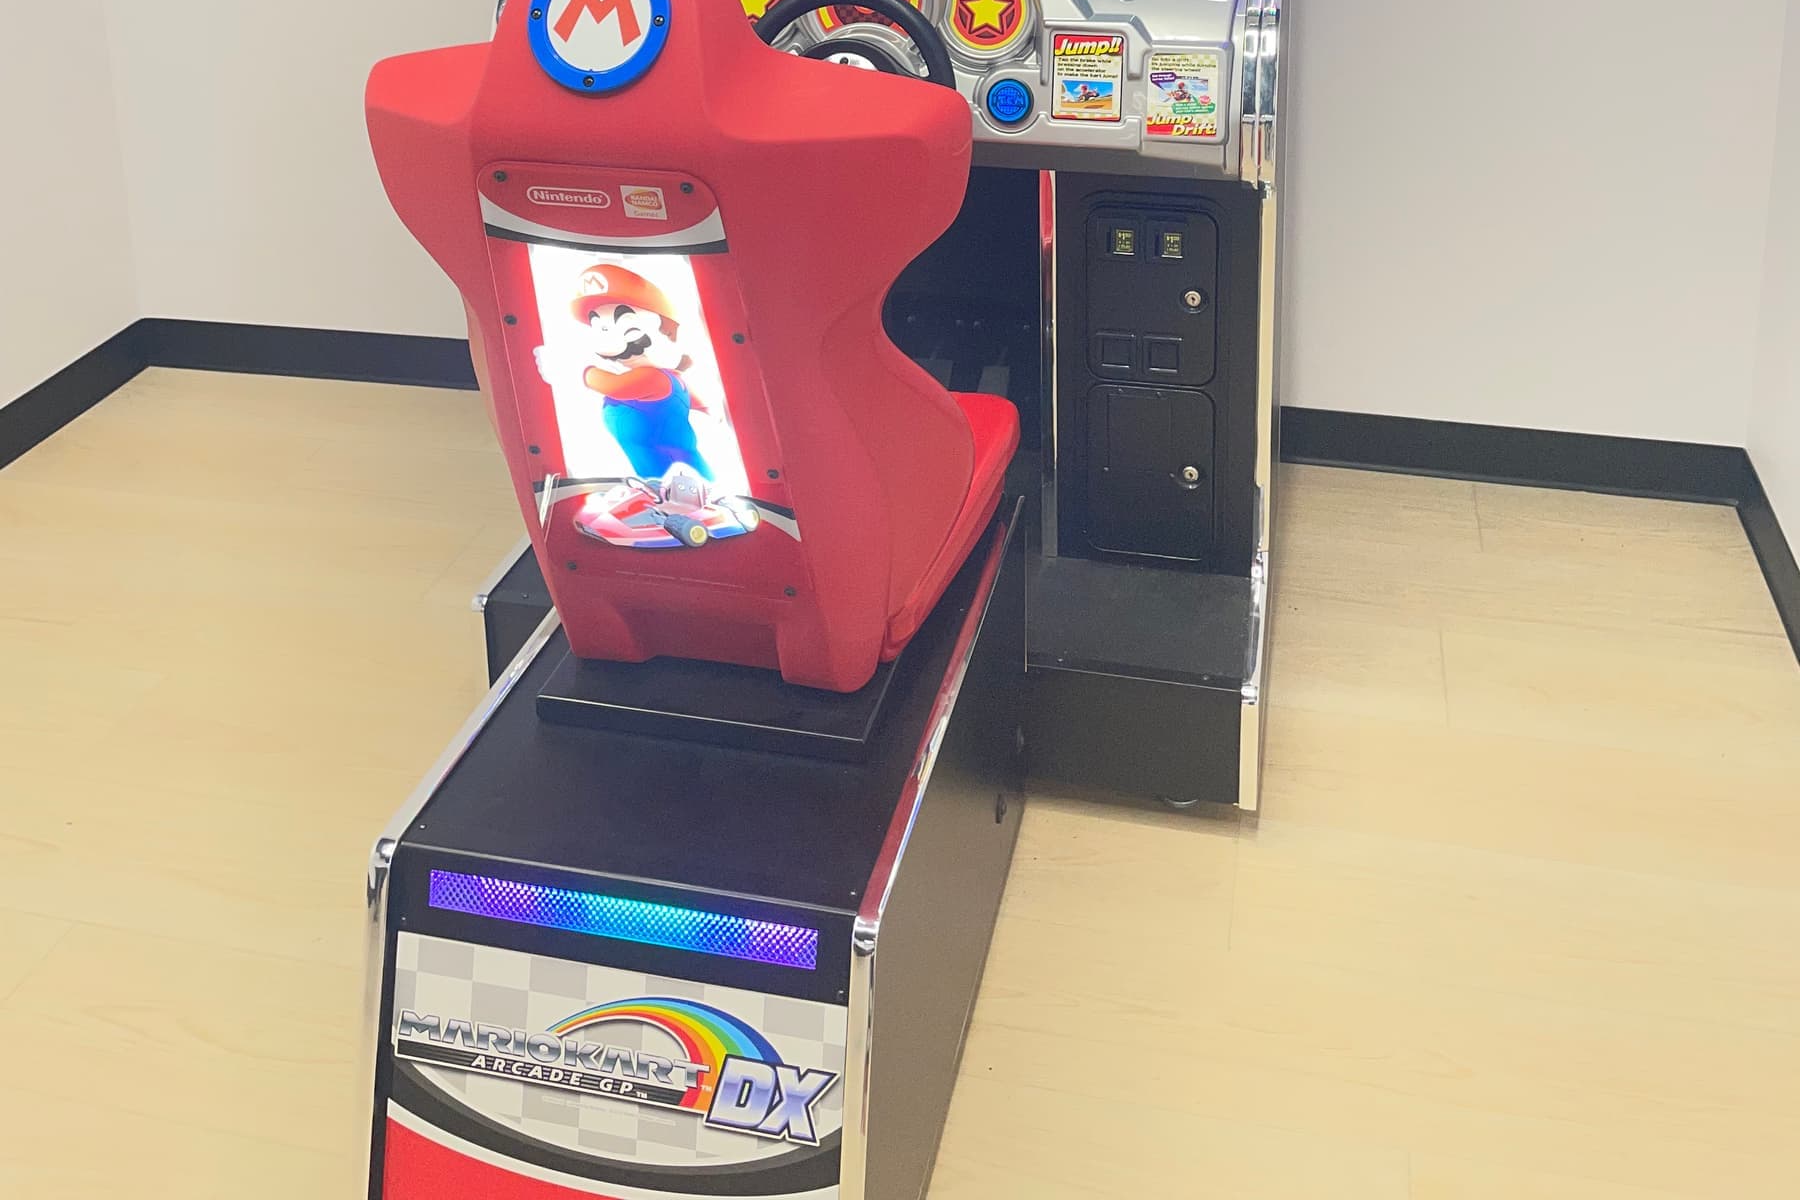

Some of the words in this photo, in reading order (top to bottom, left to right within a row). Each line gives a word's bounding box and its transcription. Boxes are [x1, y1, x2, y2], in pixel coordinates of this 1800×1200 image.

[532, 189, 603, 205] Nintendo
[630, 199, 658, 207] NAMCO
[470, 1053, 584, 1087] ARCADE
[599, 1078, 634, 1095] GP
[706, 1054, 840, 1144] DX
